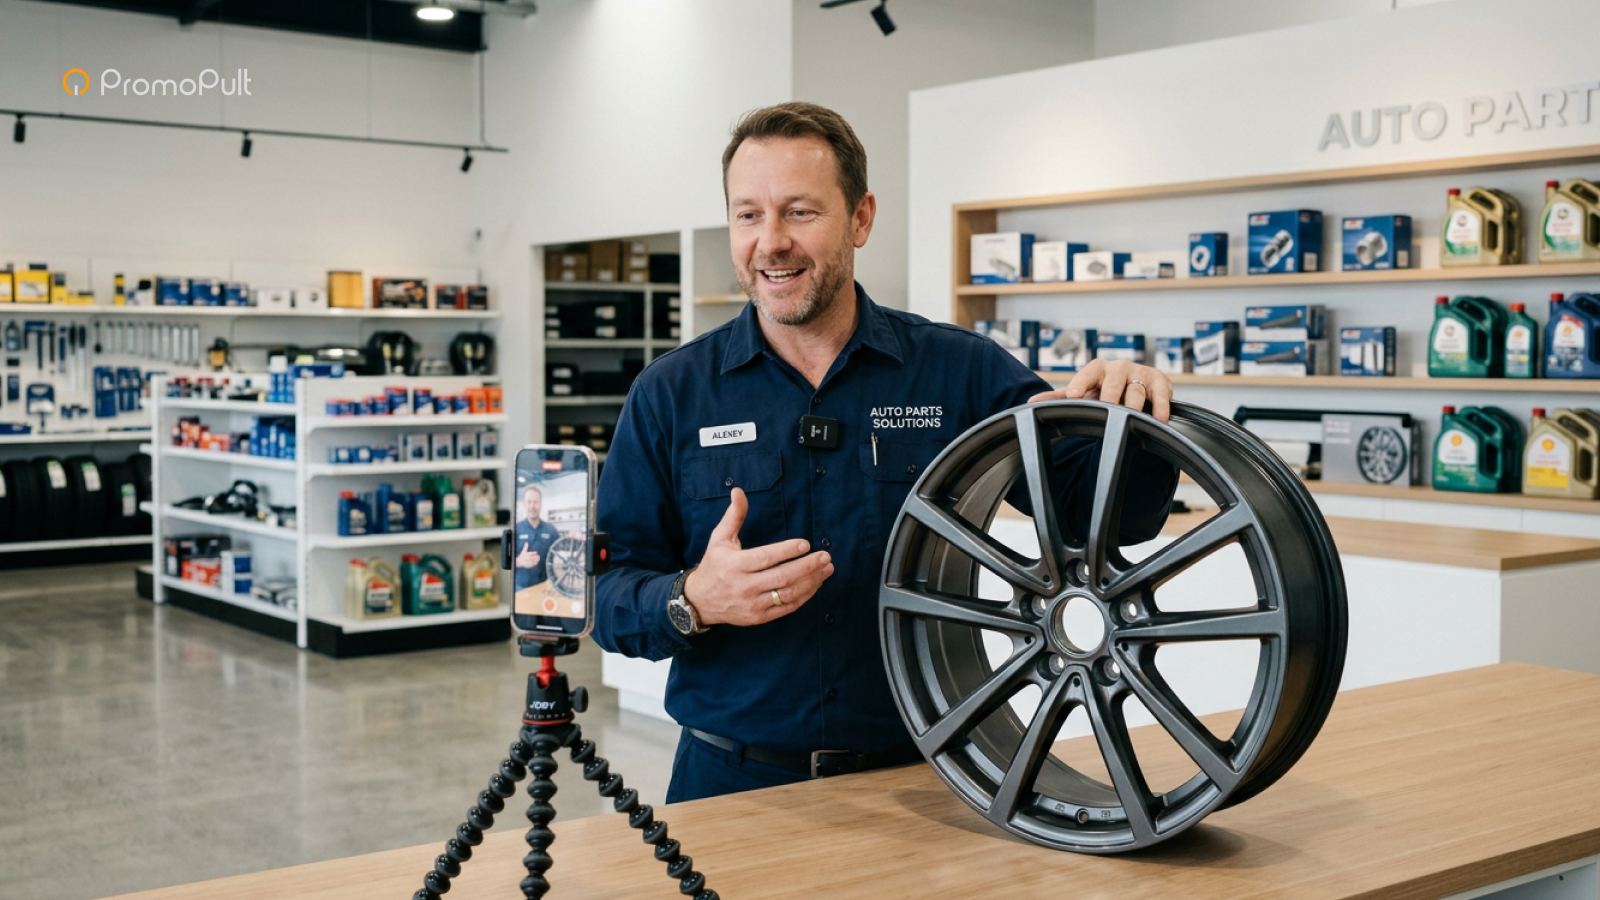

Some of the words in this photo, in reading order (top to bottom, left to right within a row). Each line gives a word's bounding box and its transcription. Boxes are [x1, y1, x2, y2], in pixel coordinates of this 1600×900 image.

[1318, 101, 1448, 151] AUTO
[869, 406, 903, 417] AUTO
[905, 405, 943, 416] PARTS
[873, 417, 941, 428] SOLUTIONS
